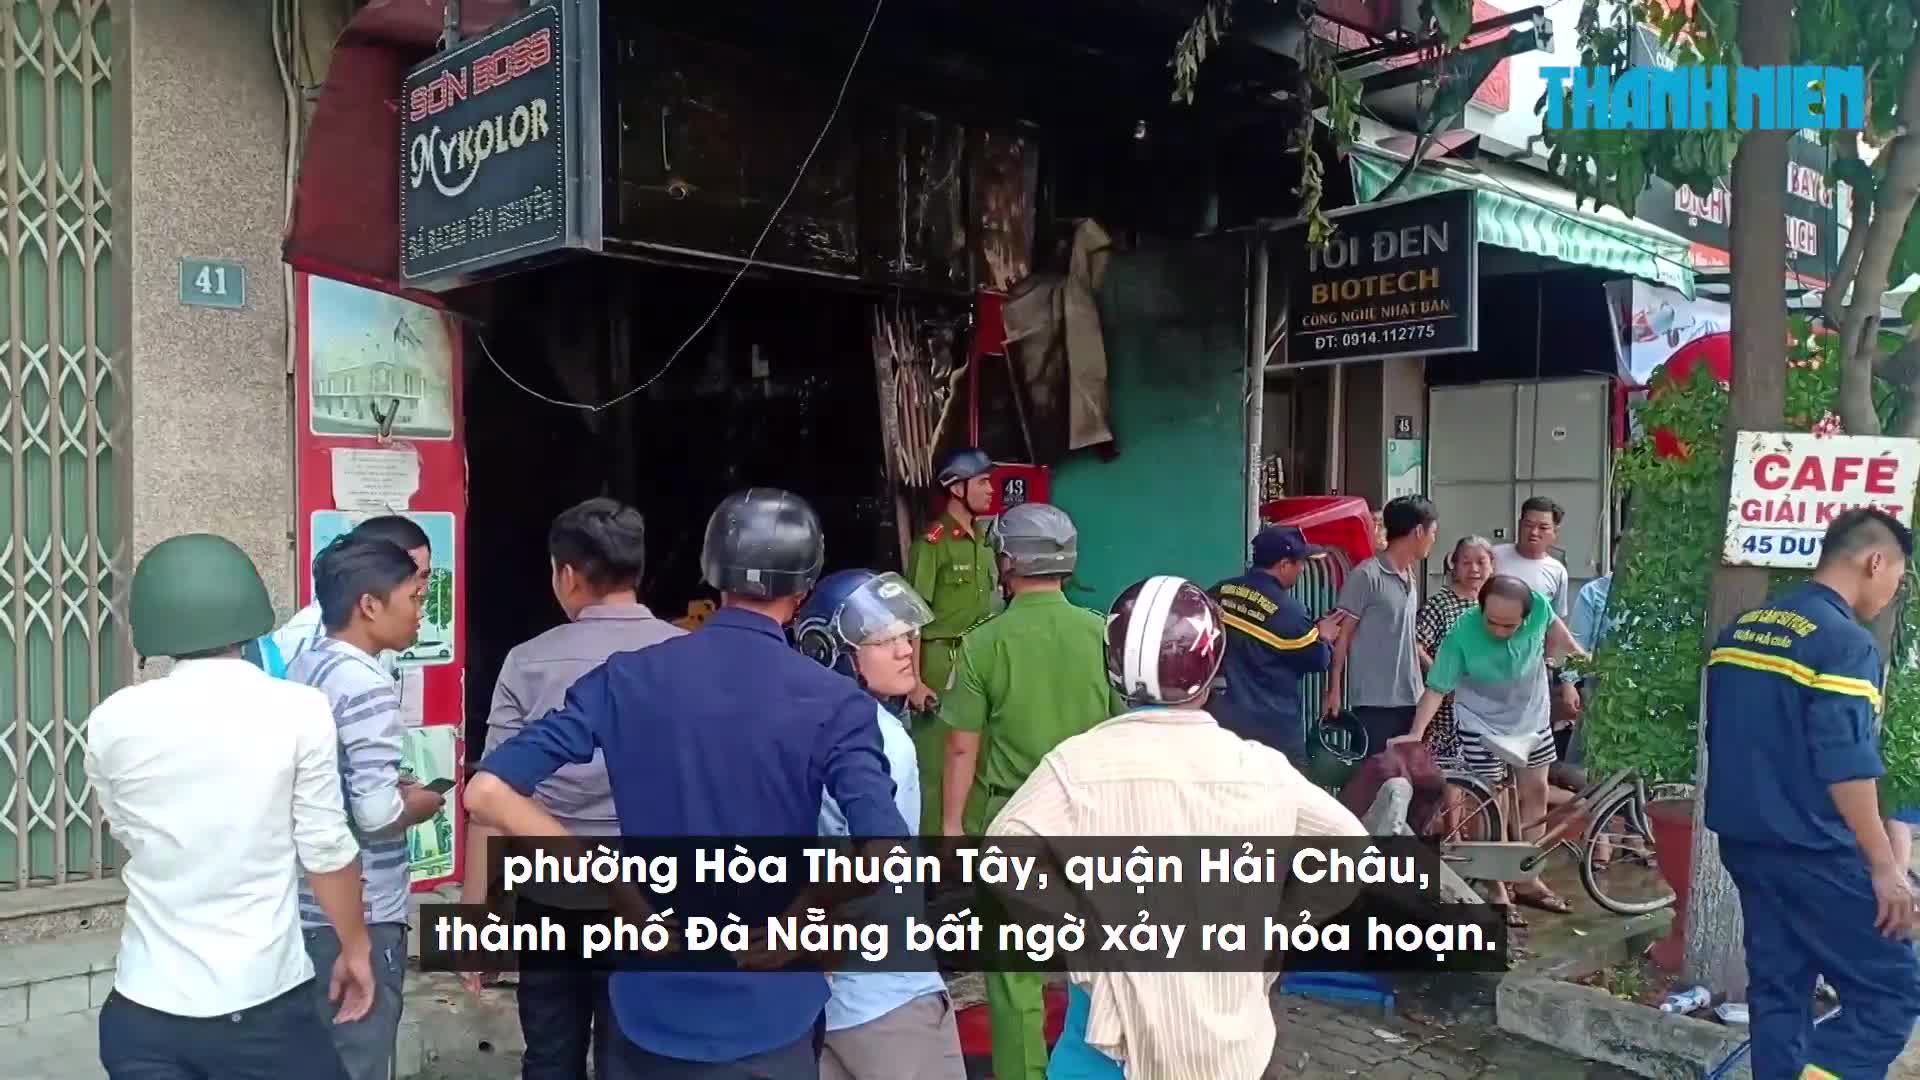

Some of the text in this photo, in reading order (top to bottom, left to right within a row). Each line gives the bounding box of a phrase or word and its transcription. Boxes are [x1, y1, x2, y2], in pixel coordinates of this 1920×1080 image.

[472, 28, 551, 96] BOSS
[410, 98, 549, 197] MYKOLOR
[1372, 221, 1449, 263] ĐEN
[195, 265, 227, 295] 41
[1312, 267, 1440, 304] BIOTECH
[1315, 324, 1436, 351] ĐT: 0914.112775
[1004, 479, 1024, 495] 43
[1754, 450, 1899, 494] CAFÉ
[1741, 494, 1904, 524] GIẢI KT
[1743, 535, 1773, 555] 45
